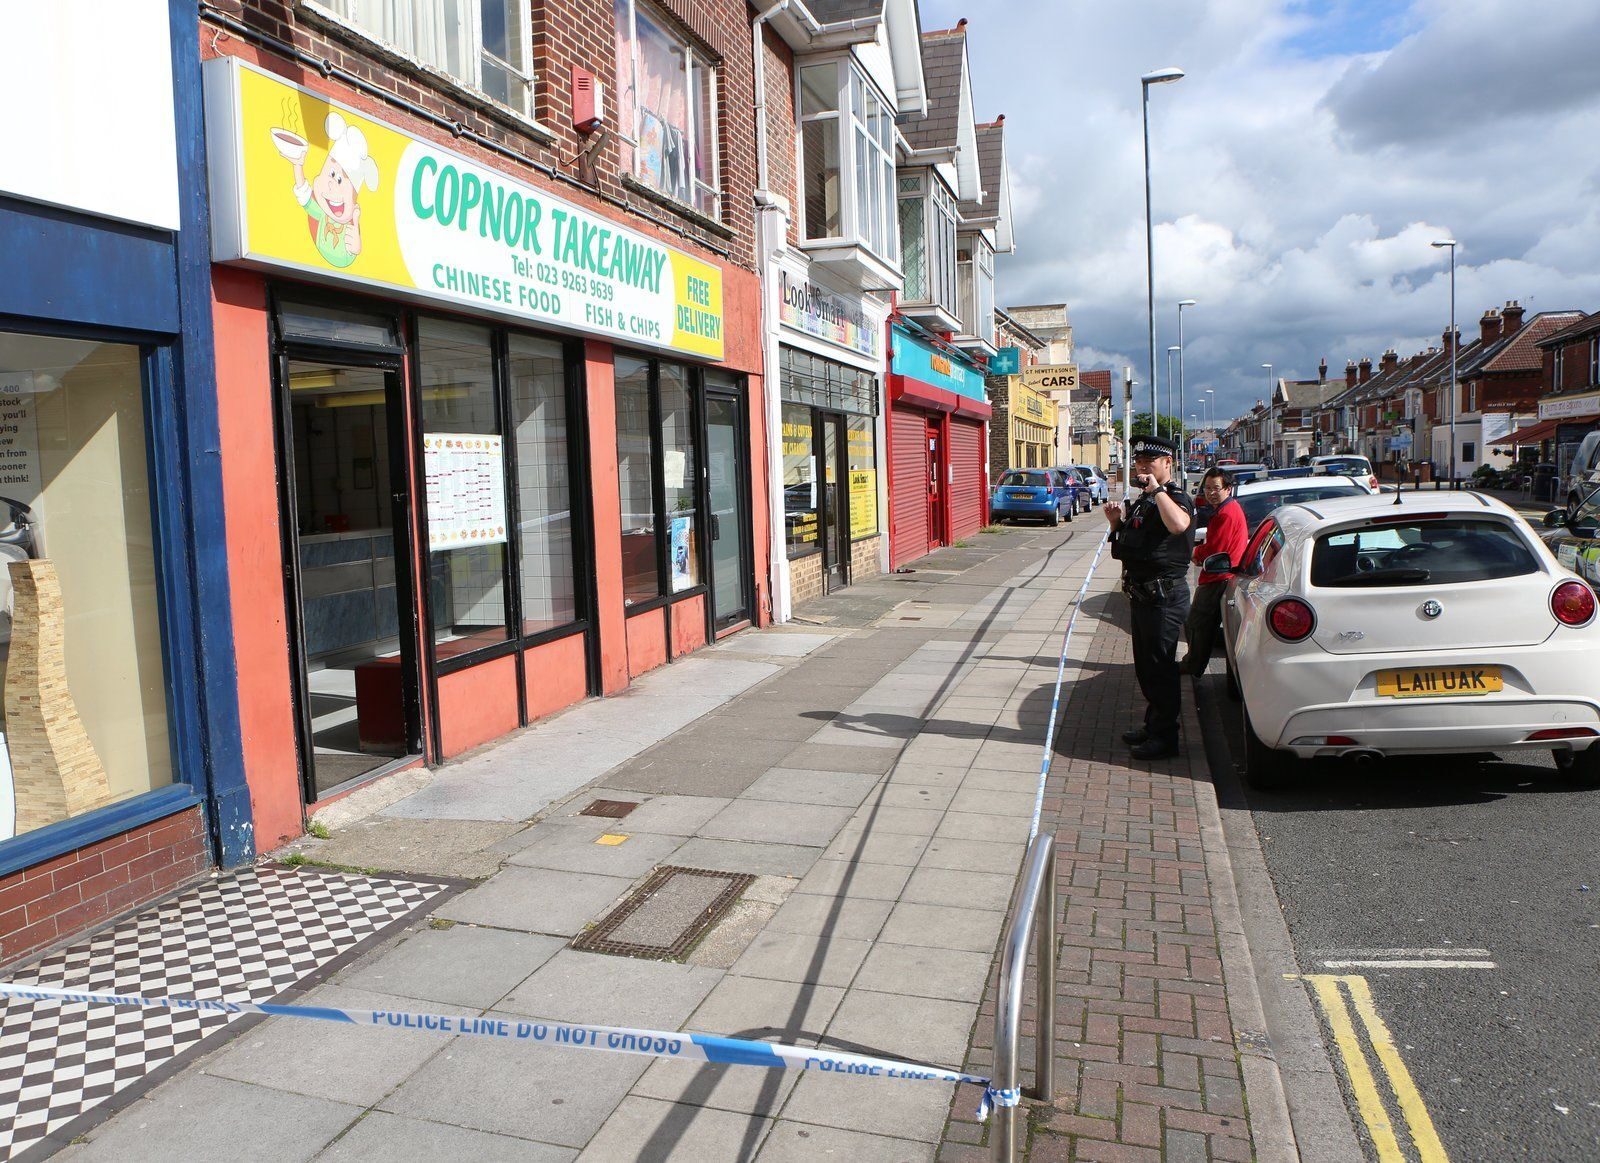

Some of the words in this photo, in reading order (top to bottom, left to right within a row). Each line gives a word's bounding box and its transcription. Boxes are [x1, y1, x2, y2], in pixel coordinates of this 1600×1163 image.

[411, 155, 542, 256] COPNOR
[551, 208, 667, 294] TAKEAWAY
[432, 263, 512, 304] CHINESE
[519, 285, 561, 315] FOOD
[511, 254, 533, 279] Tel:
[536, 262, 558, 285] 023
[562, 270, 587, 294] 9263
[590, 280, 613, 302] 9639
[687, 275, 710, 307] FREE
[782, 270, 812, 314] Look
[585, 303, 613, 328] FISH
[618, 312, 626, 331] &
[630, 315, 660, 339] CHIPS
[677, 304, 721, 340] DELIVERY
[1041, 376, 1075, 387] CARS
[2, 409, 26, 421] you'll
[6, 450, 27, 458] from
[4, 474, 29, 484] think!
[1442, 670, 1486, 690] UAK
[459, 1017, 508, 1037] LINE
[555, 1026, 598, 1046] NOT
